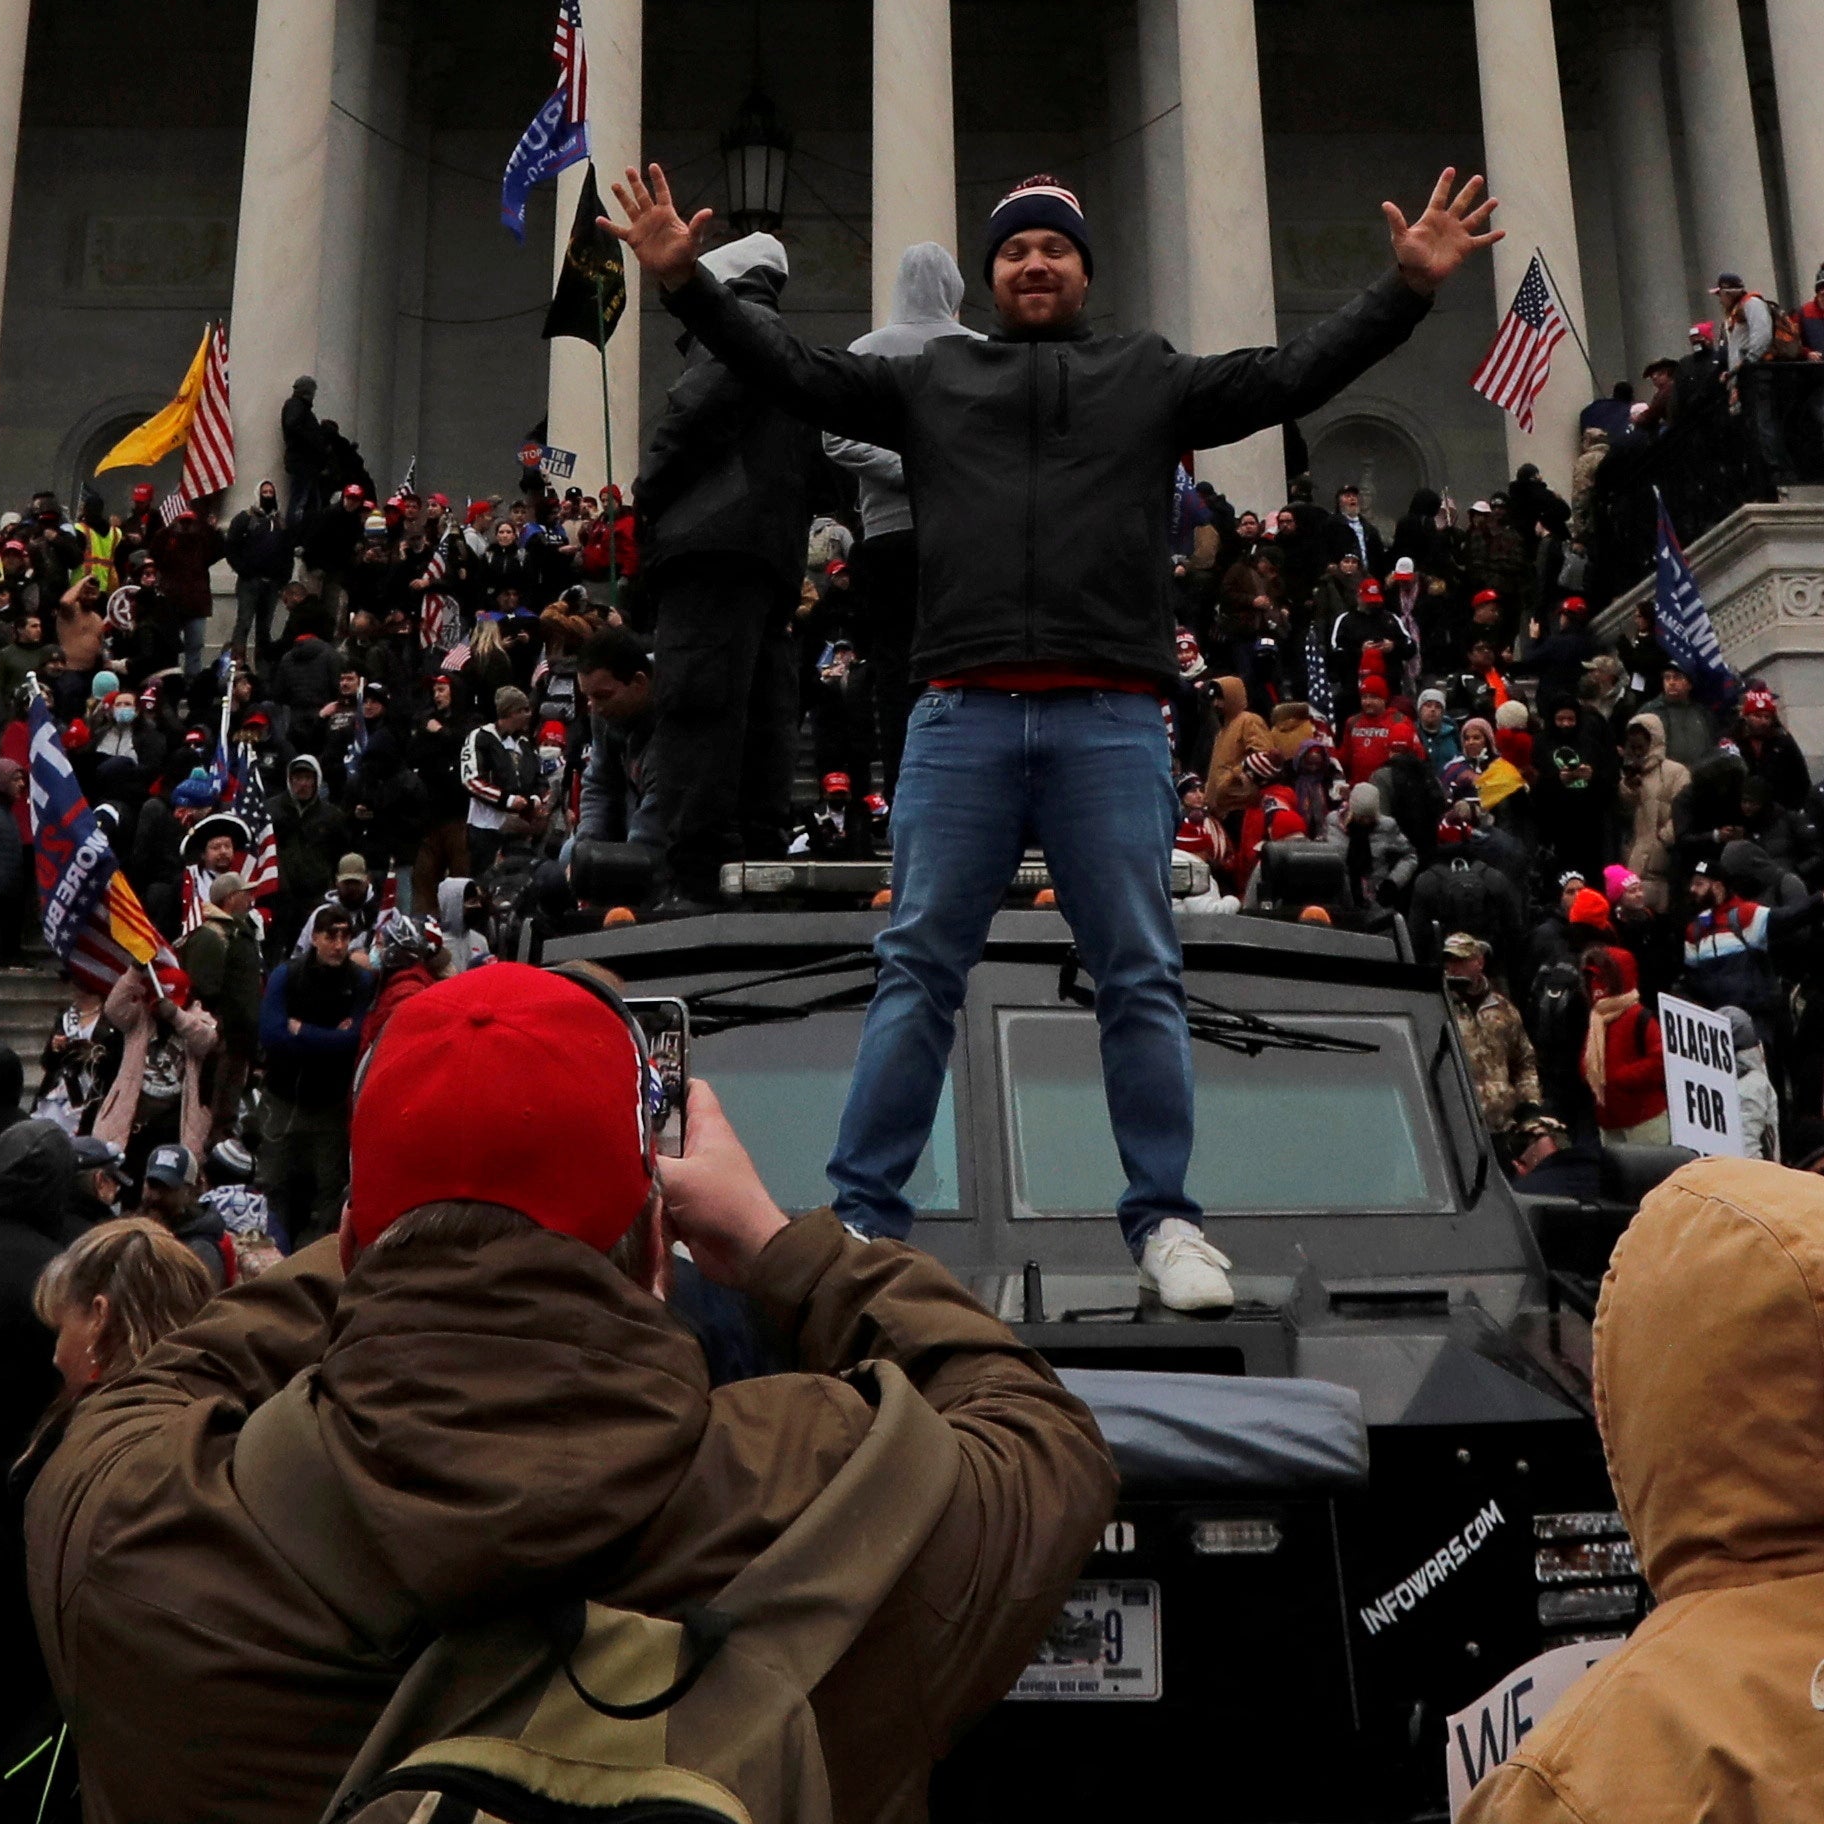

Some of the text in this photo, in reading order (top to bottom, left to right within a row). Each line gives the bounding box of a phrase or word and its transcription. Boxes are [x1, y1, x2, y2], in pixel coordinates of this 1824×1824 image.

[517, 448, 543, 462] STOP
[539, 457, 572, 477] STEAL
[551, 449, 567, 462] THE
[1663, 1009, 1733, 1074] BLACKS
[1684, 1079, 1728, 1136] FOR
[1360, 1498, 1506, 1635] INFOWARS.COM
[1078, 1680, 1100, 1693] ONLY
[1456, 1676, 1534, 1791] WE
